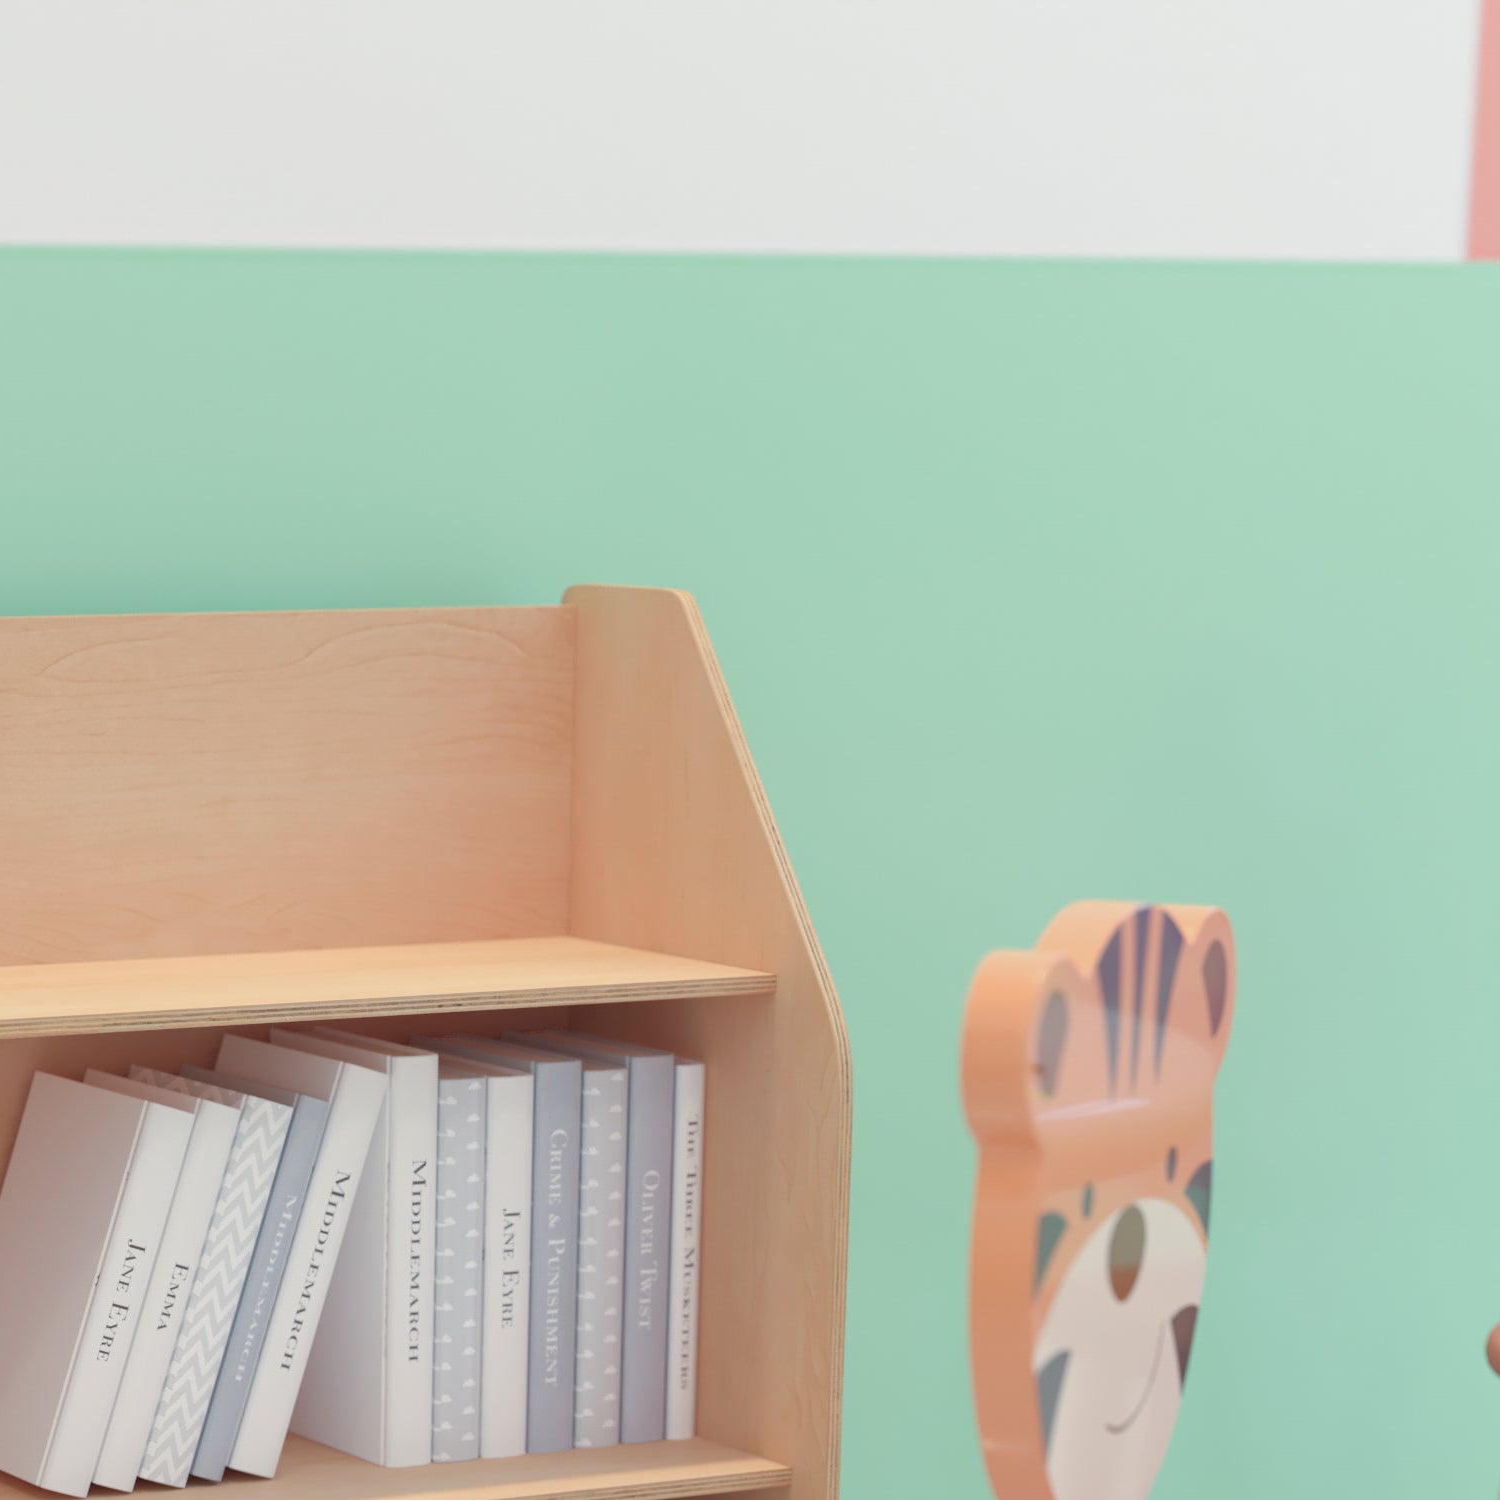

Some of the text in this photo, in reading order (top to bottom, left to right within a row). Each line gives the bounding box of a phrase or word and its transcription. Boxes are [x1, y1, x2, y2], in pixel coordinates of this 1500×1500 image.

[96, 1237, 146, 1363] JANE EYRE
[155, 1261, 190, 1331] EMMA
[234, 1194, 298, 1383] MIDDLEMARCH
[280, 1168, 352, 1372] MIDDLEMARCH
[407, 1159, 428, 1362] MIDDLEMARCH
[500, 1207, 522, 1329] JANE EYRE
[543, 1128, 569, 1388] CRIME & PUNISHMENT
[637, 1168, 660, 1331] OLIVER TWIST
[680, 1246, 696, 1391] MUSKETEERS
